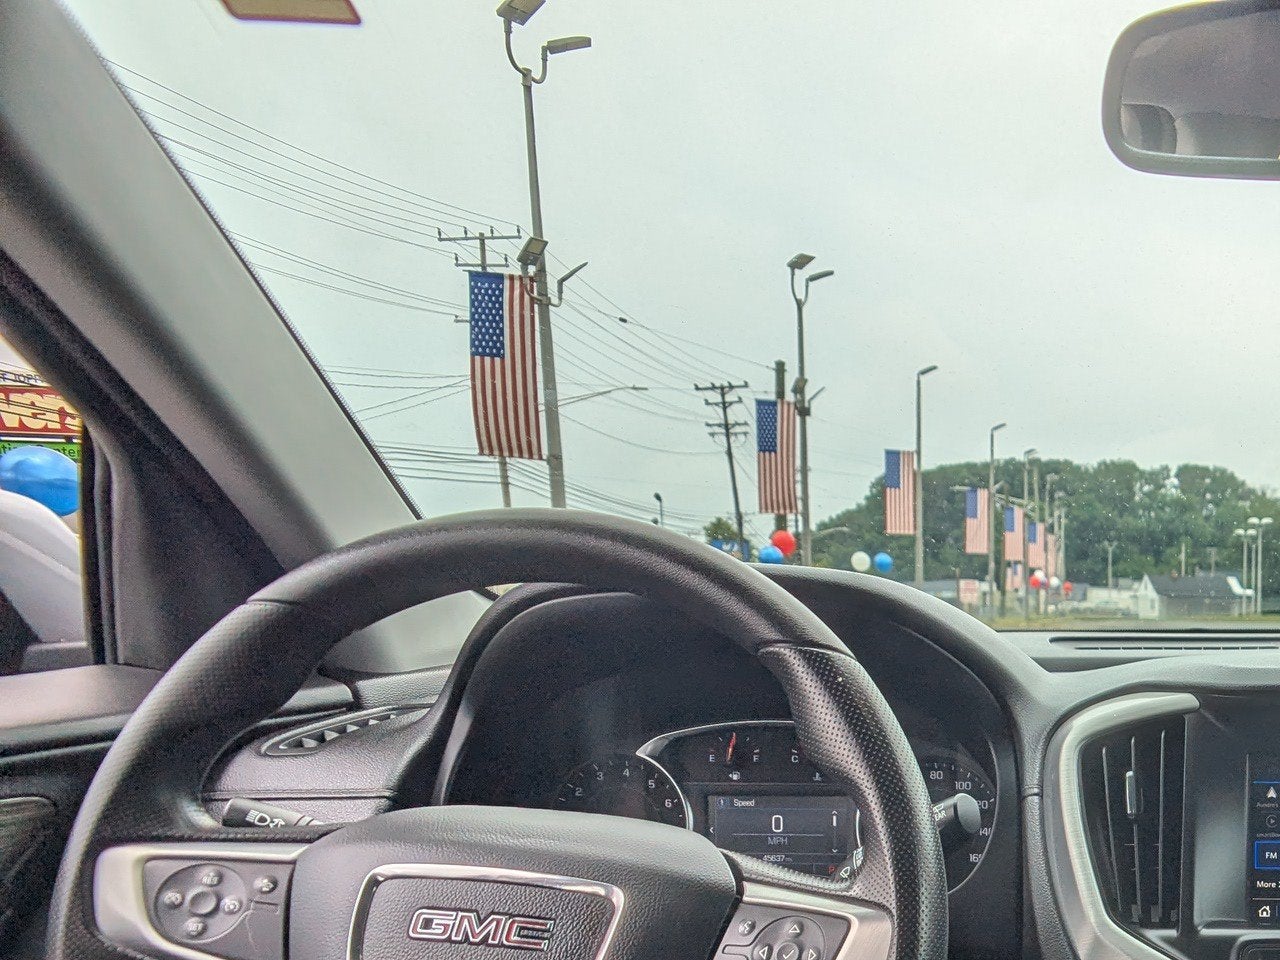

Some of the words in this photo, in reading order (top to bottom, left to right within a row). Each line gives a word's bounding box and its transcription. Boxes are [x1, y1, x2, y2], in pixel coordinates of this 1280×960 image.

[709, 754, 715, 762] E
[753, 754, 759, 762] F
[791, 755, 799, 763] C
[622, 768, 630, 778] 4
[929, 770, 943, 780] 80
[648, 779, 656, 789] 5
[954, 781, 972, 790] 100
[664, 799, 672, 808] 6
[733, 799, 755, 808] Speed
[771, 815, 784, 832] 0
[767, 836, 788, 845] MPH
[1265, 851, 1278, 860] FM
[1256, 880, 1277, 888] More
[409, 908, 554, 950] GMC
